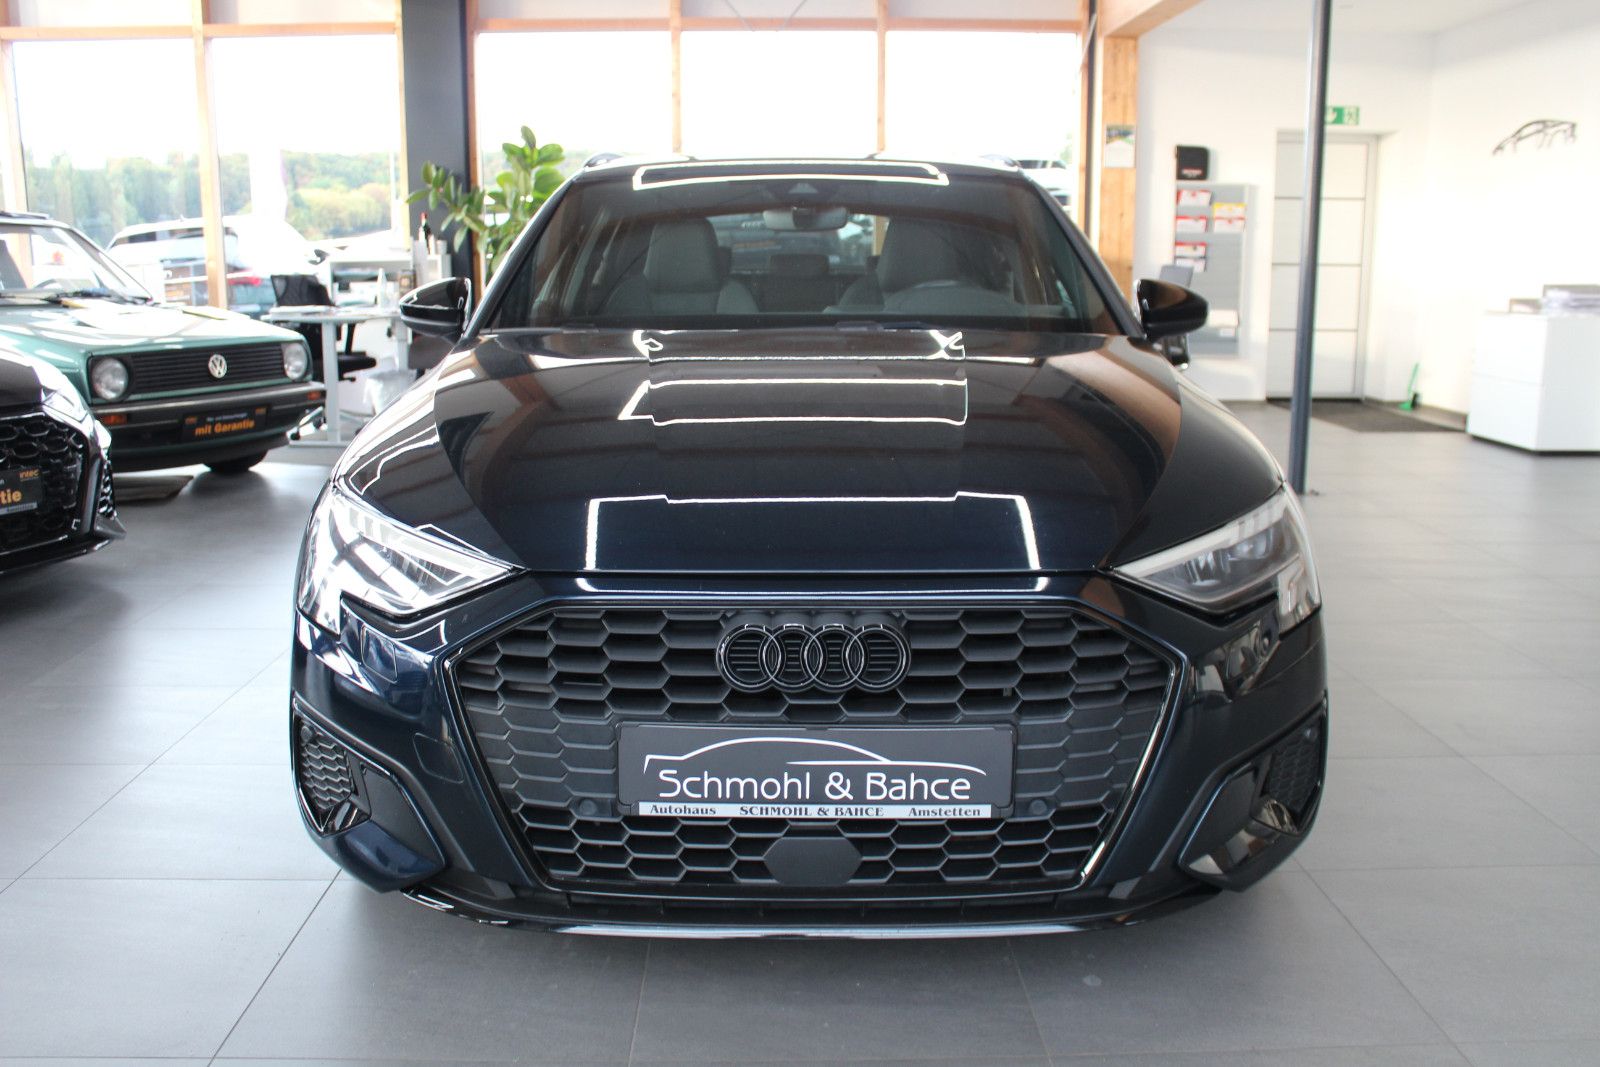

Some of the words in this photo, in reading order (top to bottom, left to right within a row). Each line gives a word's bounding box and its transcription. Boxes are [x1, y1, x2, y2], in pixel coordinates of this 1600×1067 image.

[195, 425, 212, 436] mit
[214, 420, 254, 433] Garantie
[658, 770, 810, 800] Schmohl
[824, 771, 854, 800] &
[865, 772, 971, 800] Bahce
[650, 804, 717, 816] Autohaus
[739, 805, 813, 817] SCHMOHL
[816, 806, 830, 817] &
[835, 806, 884, 817] BAHCE
[908, 806, 981, 817] Amstetten
